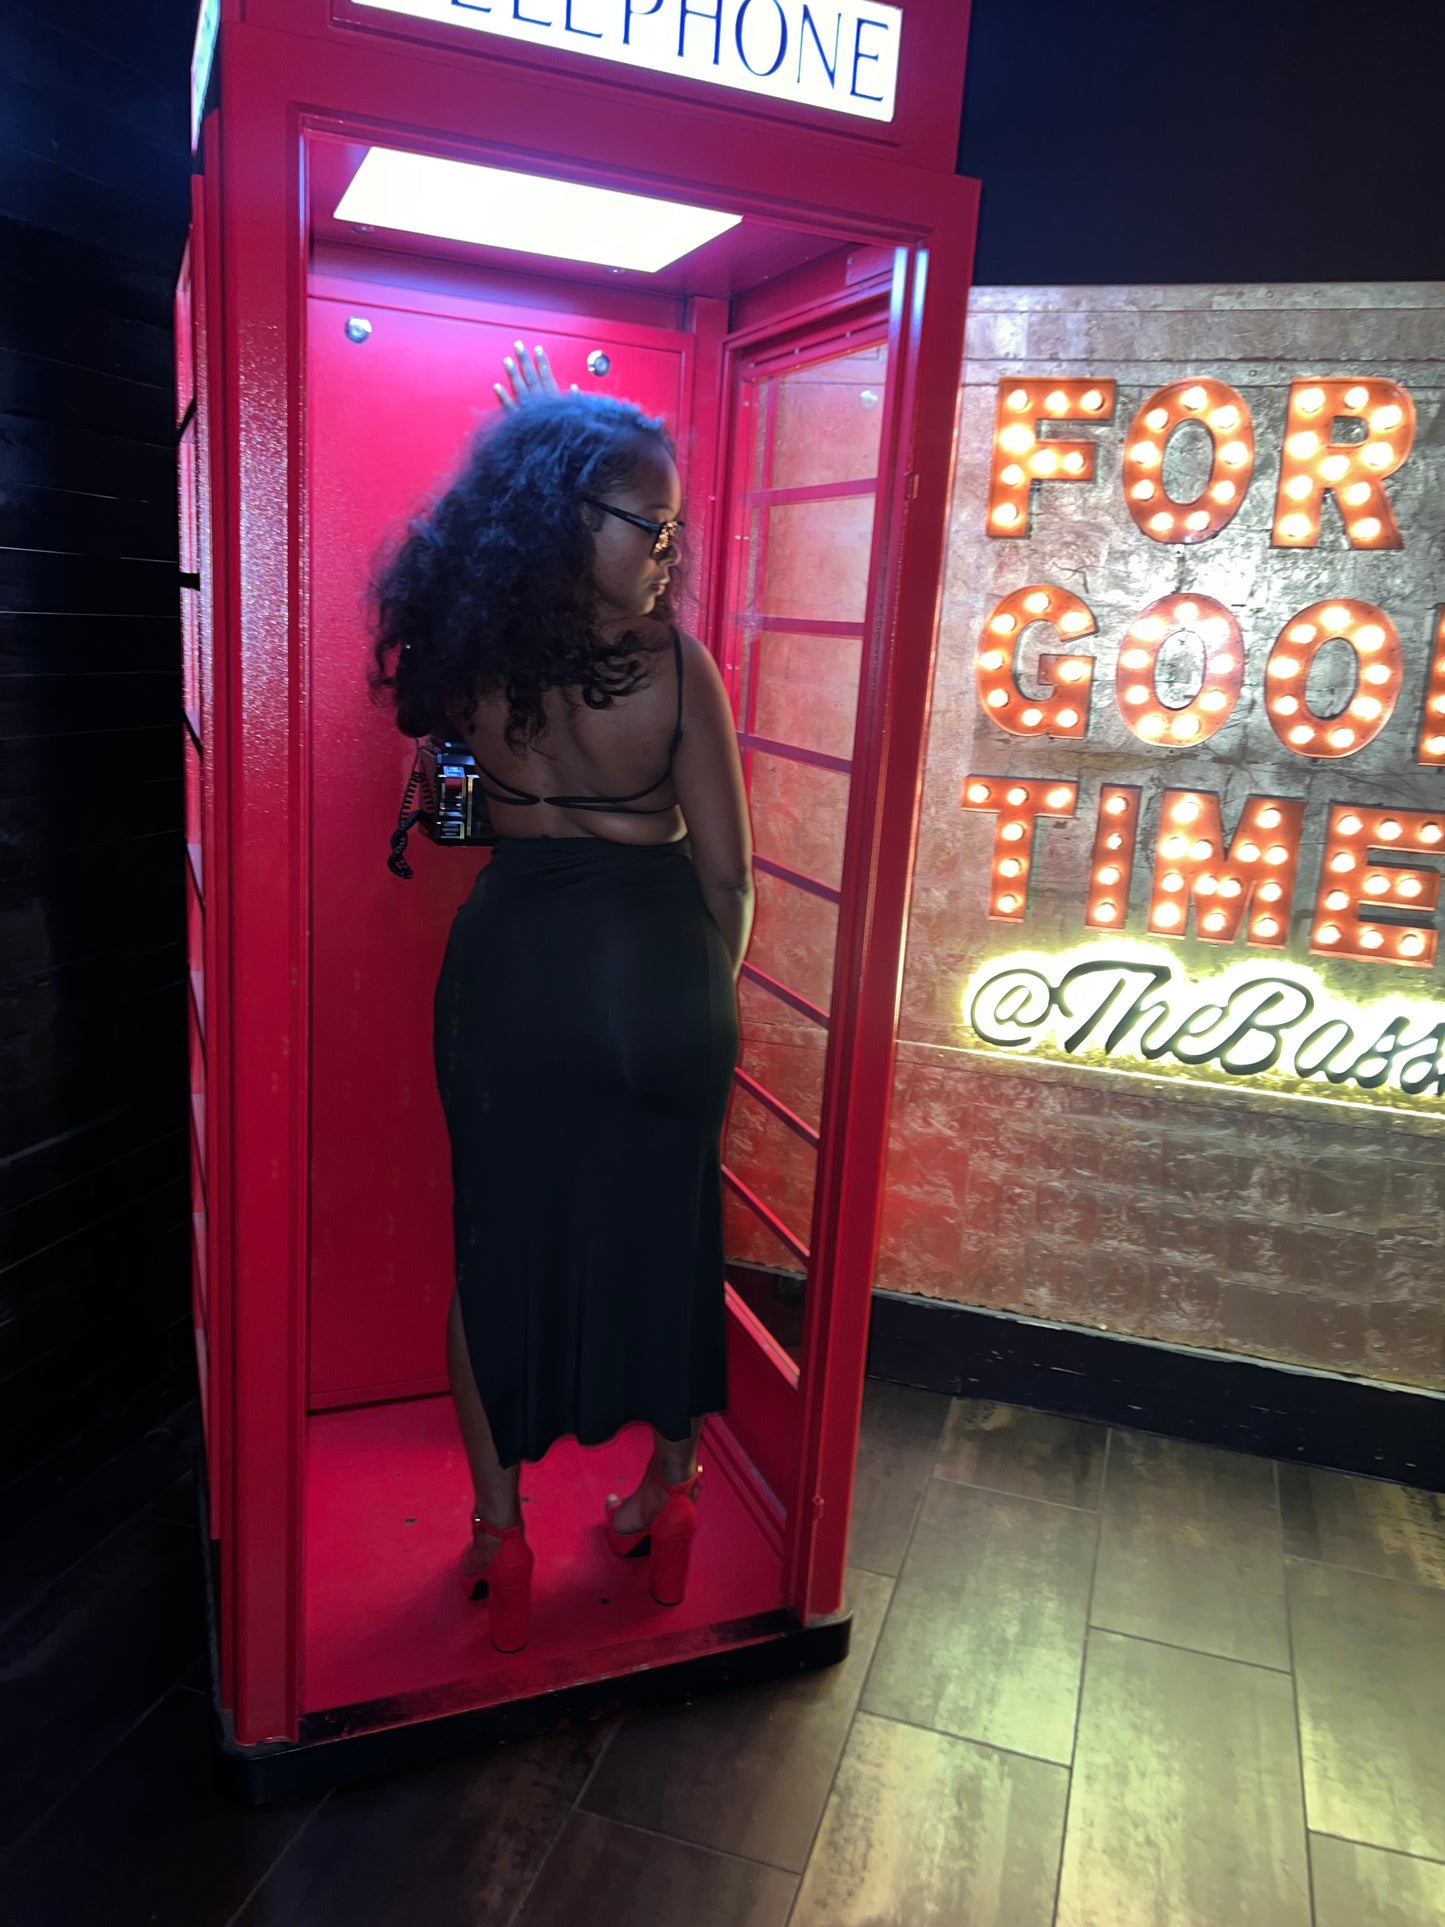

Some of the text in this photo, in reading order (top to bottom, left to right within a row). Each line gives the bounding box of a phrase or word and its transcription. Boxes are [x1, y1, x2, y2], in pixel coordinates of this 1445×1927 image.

[450, 0, 889, 102] PHONE
[986, 376, 1416, 551] FOR
[976, 583, 1445, 766] GOO
[961, 773, 1445, 969] TIME
[970, 960, 1445, 1098] @TheBass
